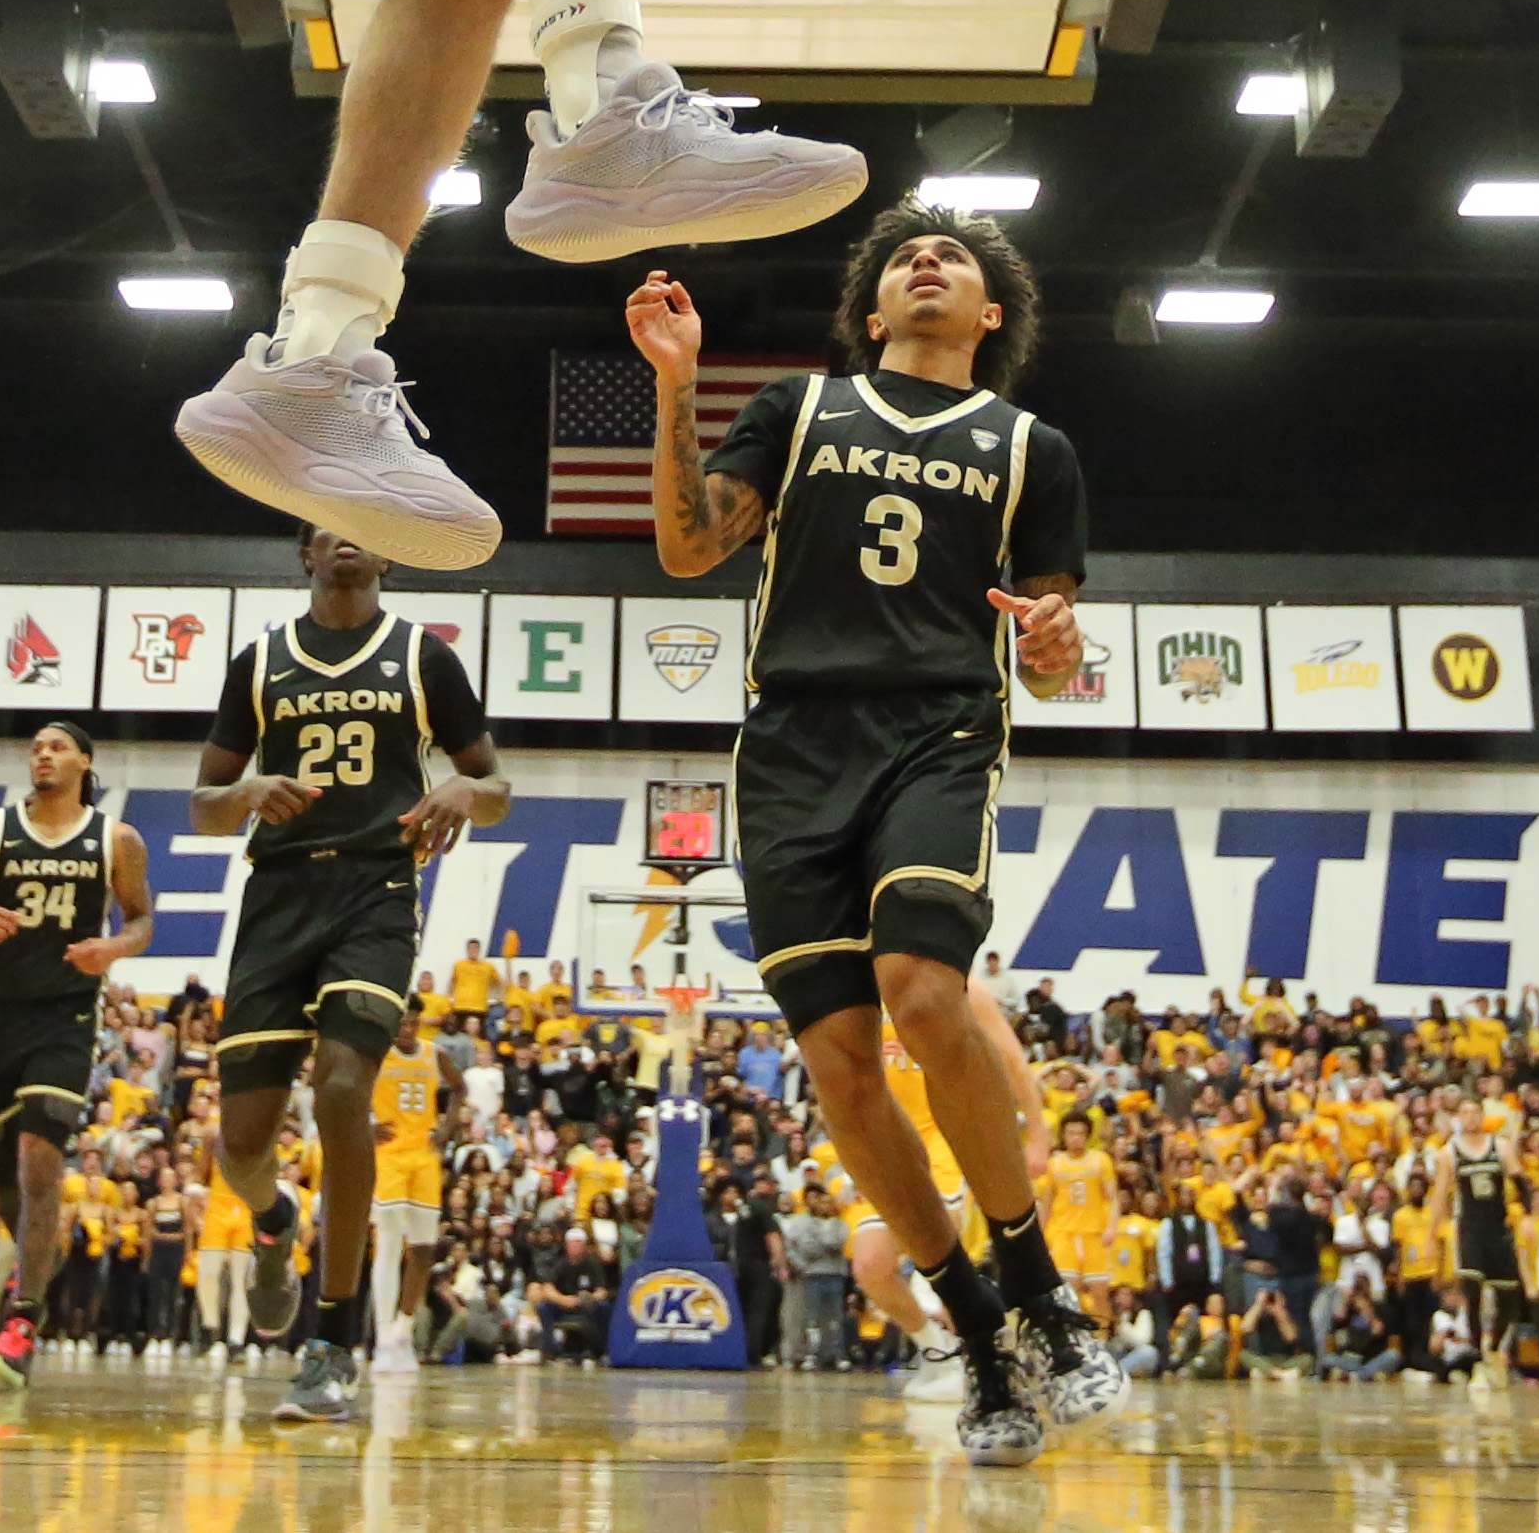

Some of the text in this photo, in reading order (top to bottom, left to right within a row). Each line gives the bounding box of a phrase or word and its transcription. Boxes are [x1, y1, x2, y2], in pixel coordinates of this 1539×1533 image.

[807, 444, 999, 503] AKRON
[860, 493, 923, 586] 3
[519, 621, 583, 693] E
[651, 644, 719, 667] MAC
[1158, 632, 1242, 685] OHIO
[1292, 661, 1380, 694] TOLEDO
[1440, 646, 1489, 692] W
[274, 688, 403, 721] AKRON
[297, 720, 376, 787] 23
[4, 858, 99, 878] AKRON
[15, 881, 77, 930] 34
